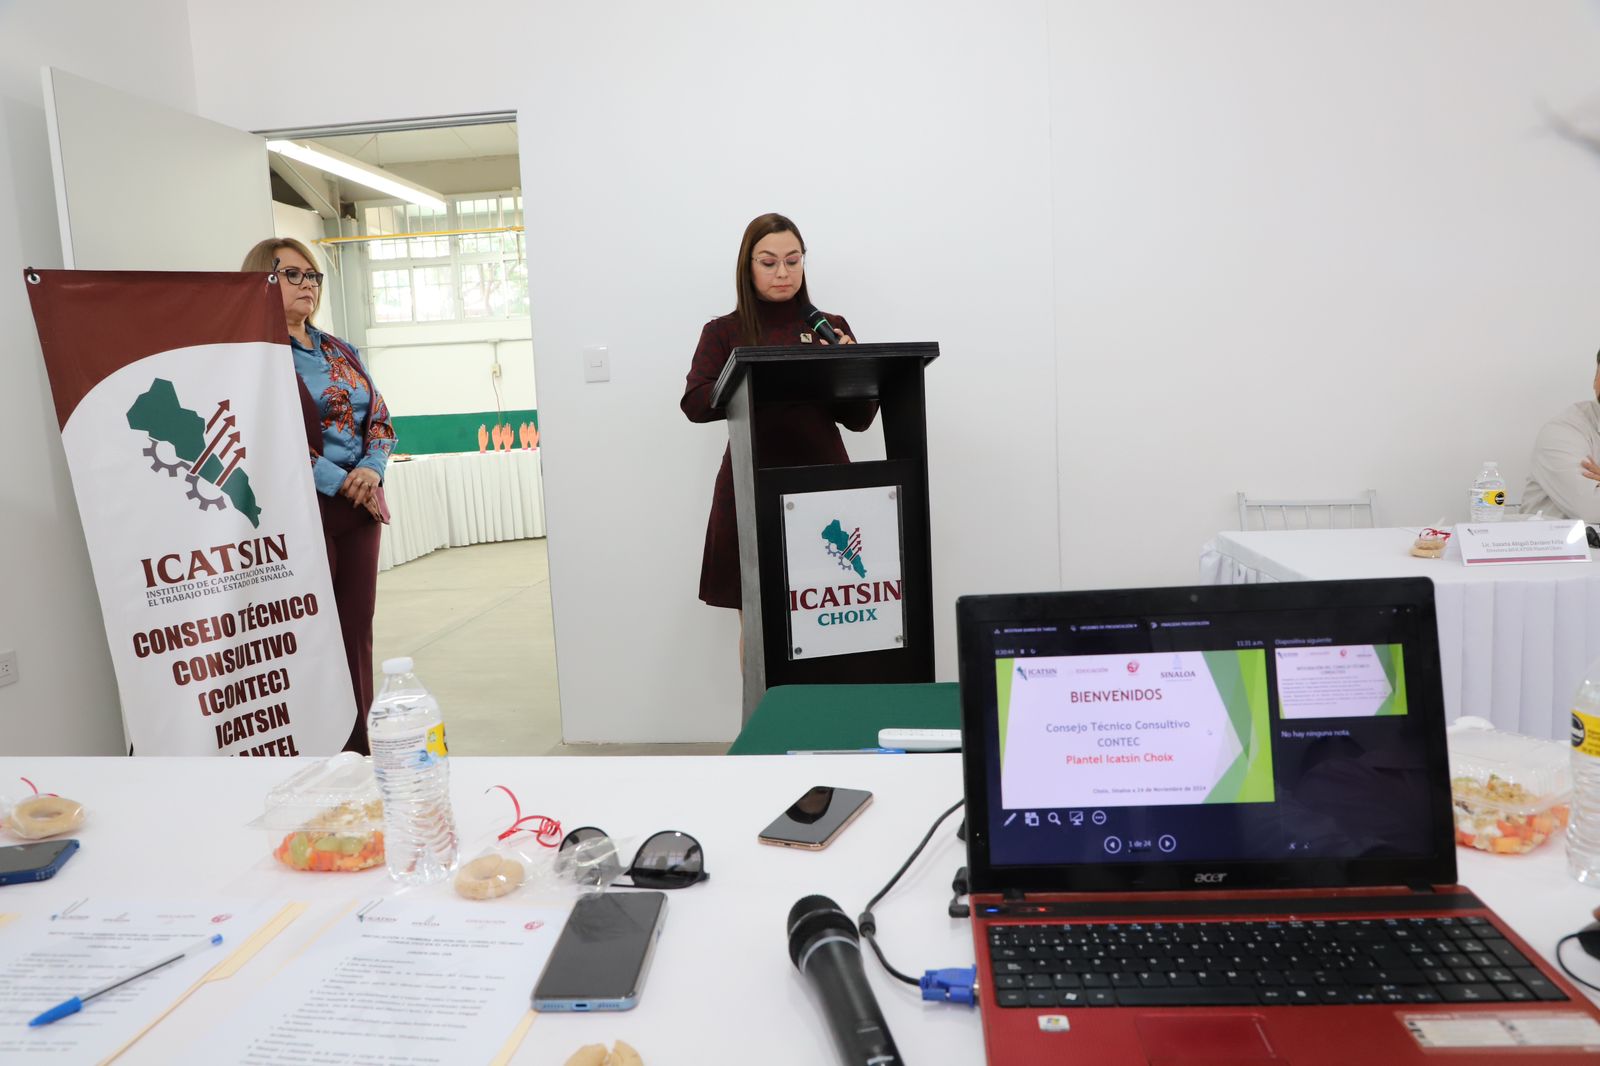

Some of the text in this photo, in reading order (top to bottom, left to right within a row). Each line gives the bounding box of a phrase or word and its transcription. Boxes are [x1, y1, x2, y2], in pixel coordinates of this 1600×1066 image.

[141, 534, 288, 587] ICATSIN
[146, 563, 287, 599] INSTITUTO DE CAPACITACIÓN PARA
[148, 570, 294, 607] EL TRABAJO DEL ESTADO DE SINALOA
[789, 579, 902, 611] ICATSIN
[132, 593, 319, 658] CONSEJO TÉCNICO
[818, 608, 878, 626] CHOIX
[172, 631, 298, 686] CONSULTIVO
[1070, 689, 1162, 703] BIENVENIDOS
[215, 702, 290, 749] ICATSIN
[1046, 723, 1088, 734] Consejo
[1135, 720, 1190, 730] Consultivo
[1066, 752, 1174, 765] Plantel Icatsin Choix
[1097, 737, 1140, 748] CONTEC
[1194, 873, 1227, 883] acer
